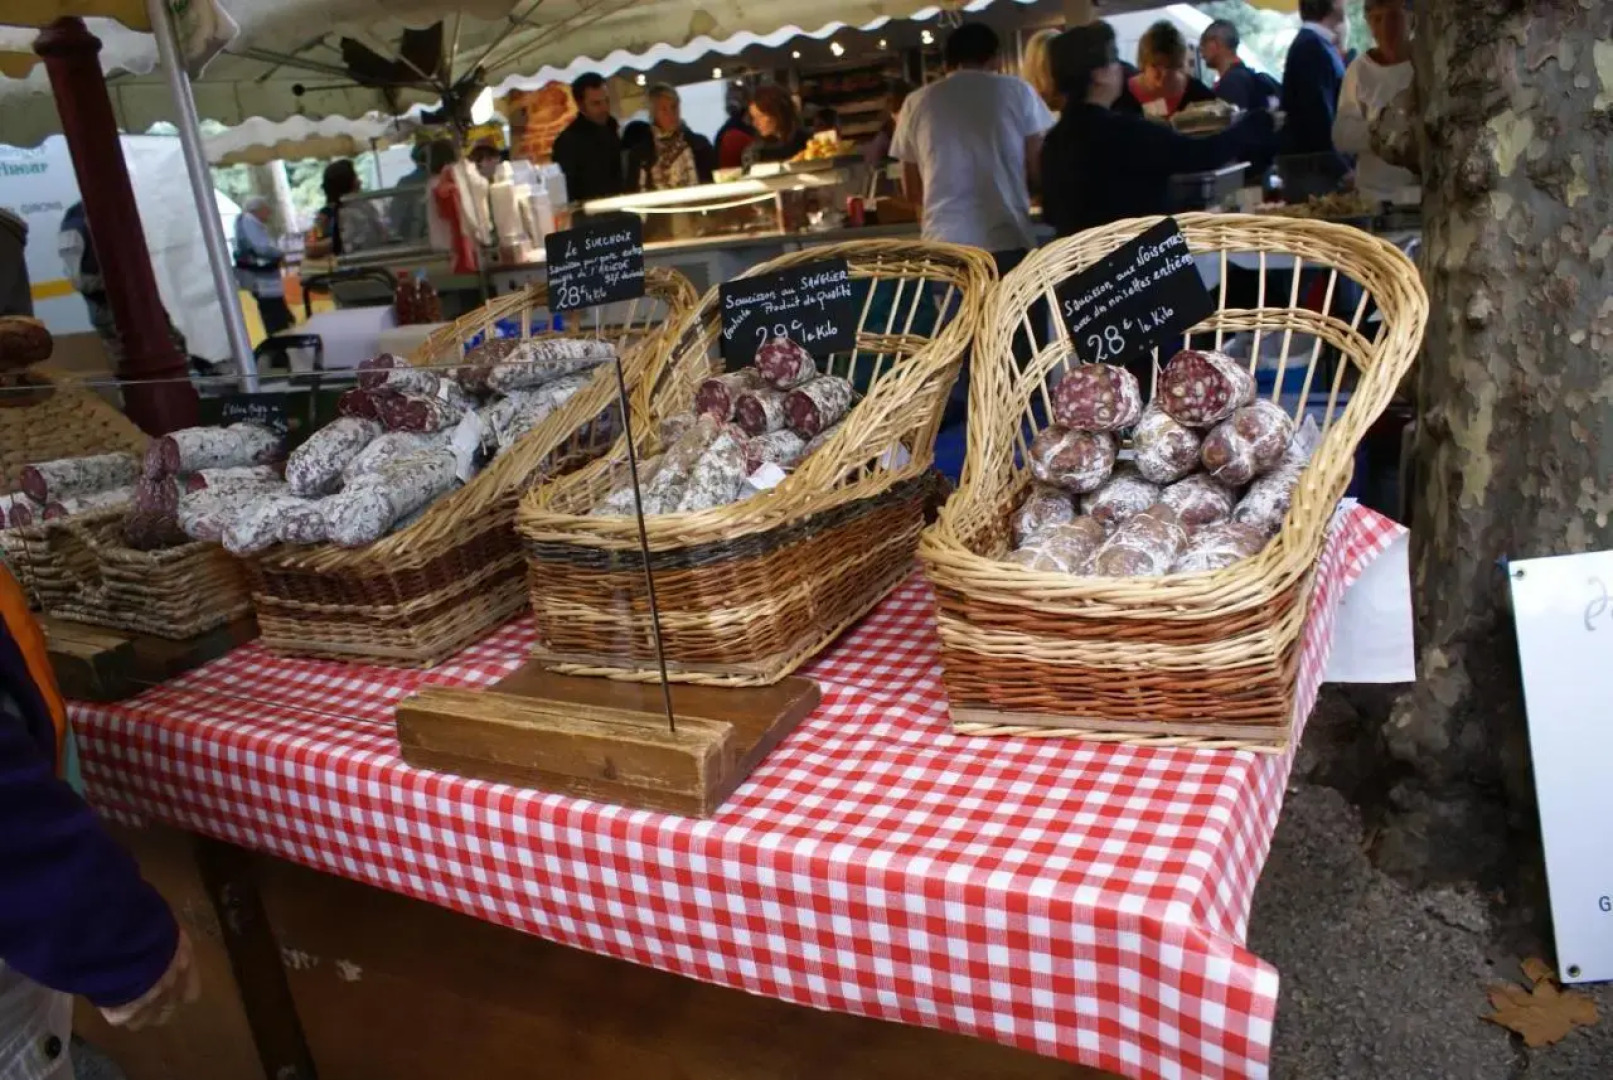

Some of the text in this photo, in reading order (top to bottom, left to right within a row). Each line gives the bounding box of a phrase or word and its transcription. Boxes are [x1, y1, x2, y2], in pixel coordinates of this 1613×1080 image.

[726, 291, 776, 310] Saucisson
[1065, 281, 1114, 317] Saucisson
[1116, 265, 1136, 281] aux
[1108, 275, 1151, 308] noisettes
[1137, 318, 1151, 333] le
[802, 328, 815, 343] le
